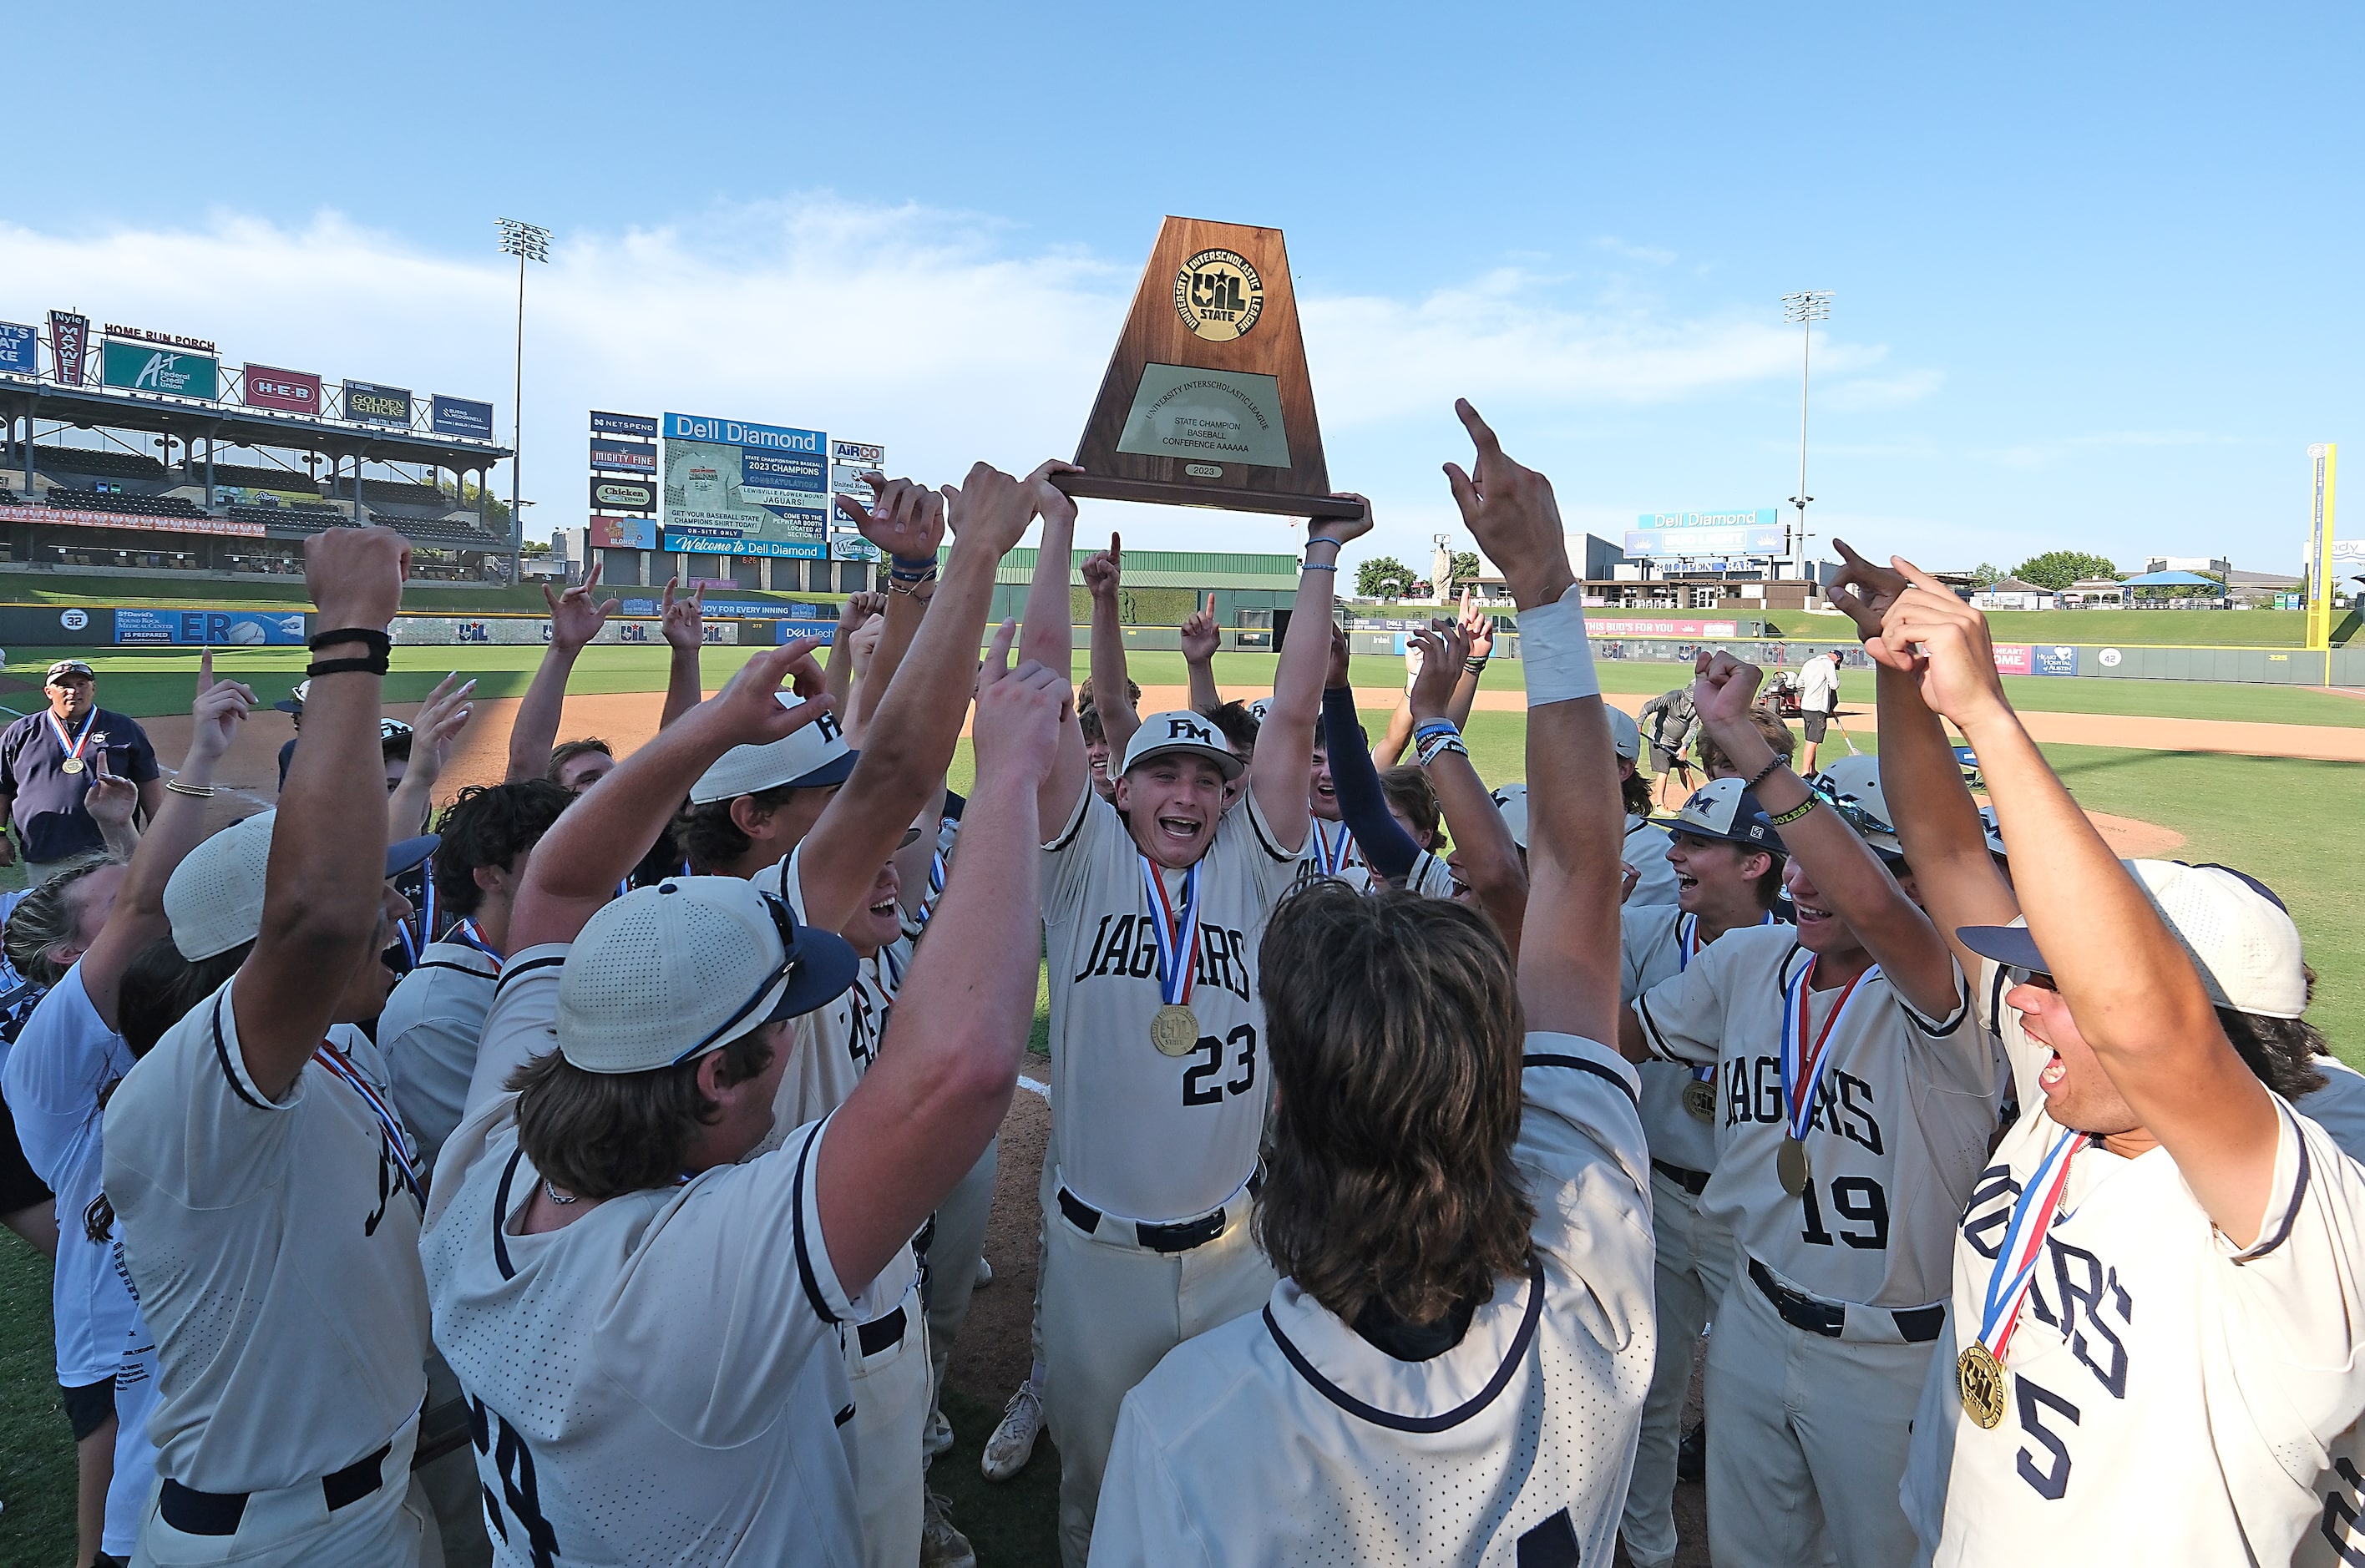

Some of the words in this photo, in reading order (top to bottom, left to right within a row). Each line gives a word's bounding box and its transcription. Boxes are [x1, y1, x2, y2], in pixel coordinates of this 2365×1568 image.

[1176, 272, 1198, 329] UNIVERSITY
[1188, 250, 1261, 290] INTERSCHOLASTIC
[1237, 298, 1262, 332] LEAGUE
[55, 311, 82, 325] Nyle
[1200, 308, 1235, 322] STATE
[104, 323, 141, 339] HOME
[147, 331, 171, 343] RUN
[175, 335, 215, 351] PORCH
[58, 325, 79, 384] MAXWELL
[160, 370, 190, 380] Federal
[160, 376, 185, 385] Credit
[160, 382, 183, 390] Union
[352, 394, 404, 410] GOLDEN
[1146, 386, 1185, 419] UNIVERSITY
[1183, 380, 1250, 405] INTERSCHOLASTIC
[1248, 402, 1269, 431] LEAGUE
[357, 403, 401, 417] CHICK
[605, 420, 654, 431] NETSPEND
[1174, 417, 1198, 427] STATE
[1199, 420, 1241, 431] CHAMPION
[677, 416, 719, 440] Dell
[727, 422, 816, 451] Diamond
[1188, 429, 1227, 440] BASEBALL
[1162, 438, 1215, 449] CONFERENCE
[1216, 443, 1249, 453] AAAAAA
[595, 453, 628, 463] MIGHTY
[633, 456, 652, 465] FINE
[761, 456, 799, 465] CHAMPIONSHIPS
[749, 462, 769, 471] 2023
[772, 464, 819, 476] CHAMPIONS
[1193, 467, 1214, 475] 2023
[256, 491, 281, 502] Starry
[605, 488, 643, 497] Chicken
[763, 496, 805, 506] JAGUARS!
[674, 517, 717, 526] CHAMPIONS
[706, 513, 738, 521] BASEBALL
[1654, 513, 1684, 529] Dell
[1688, 511, 1757, 527] Diamond
[687, 528, 717, 536] ON-SITE
[676, 537, 732, 552] Welcome
[733, 539, 745, 553] to
[748, 543, 768, 554] Dell
[772, 544, 818, 557] Diamond
[2332, 543, 2358, 554] ody
[1653, 562, 1712, 573] BULLPEN
[1725, 561, 1755, 571] BAR
[719, 605, 734, 614] FOR
[762, 606, 788, 615] INNING
[67, 617, 82, 626] 32
[180, 612, 232, 643] ER
[1585, 622, 1604, 631] THIS
[1606, 623, 1633, 632] BUD'S
[1635, 623, 1651, 632] FOR
[1653, 624, 1674, 632] YOU
[787, 628, 811, 638] DELL
[813, 628, 834, 638] Tech
[1993, 655, 2025, 665] OME.
[1167, 719, 1214, 745] FM
[1771, 800, 1815, 826] OOLEST.
[1074, 913, 1250, 1003] JAGRS
[1182, 1023, 1257, 1106] 23
[1801, 1176, 1889, 1250] 19
[2014, 1371, 2080, 1500] 5
